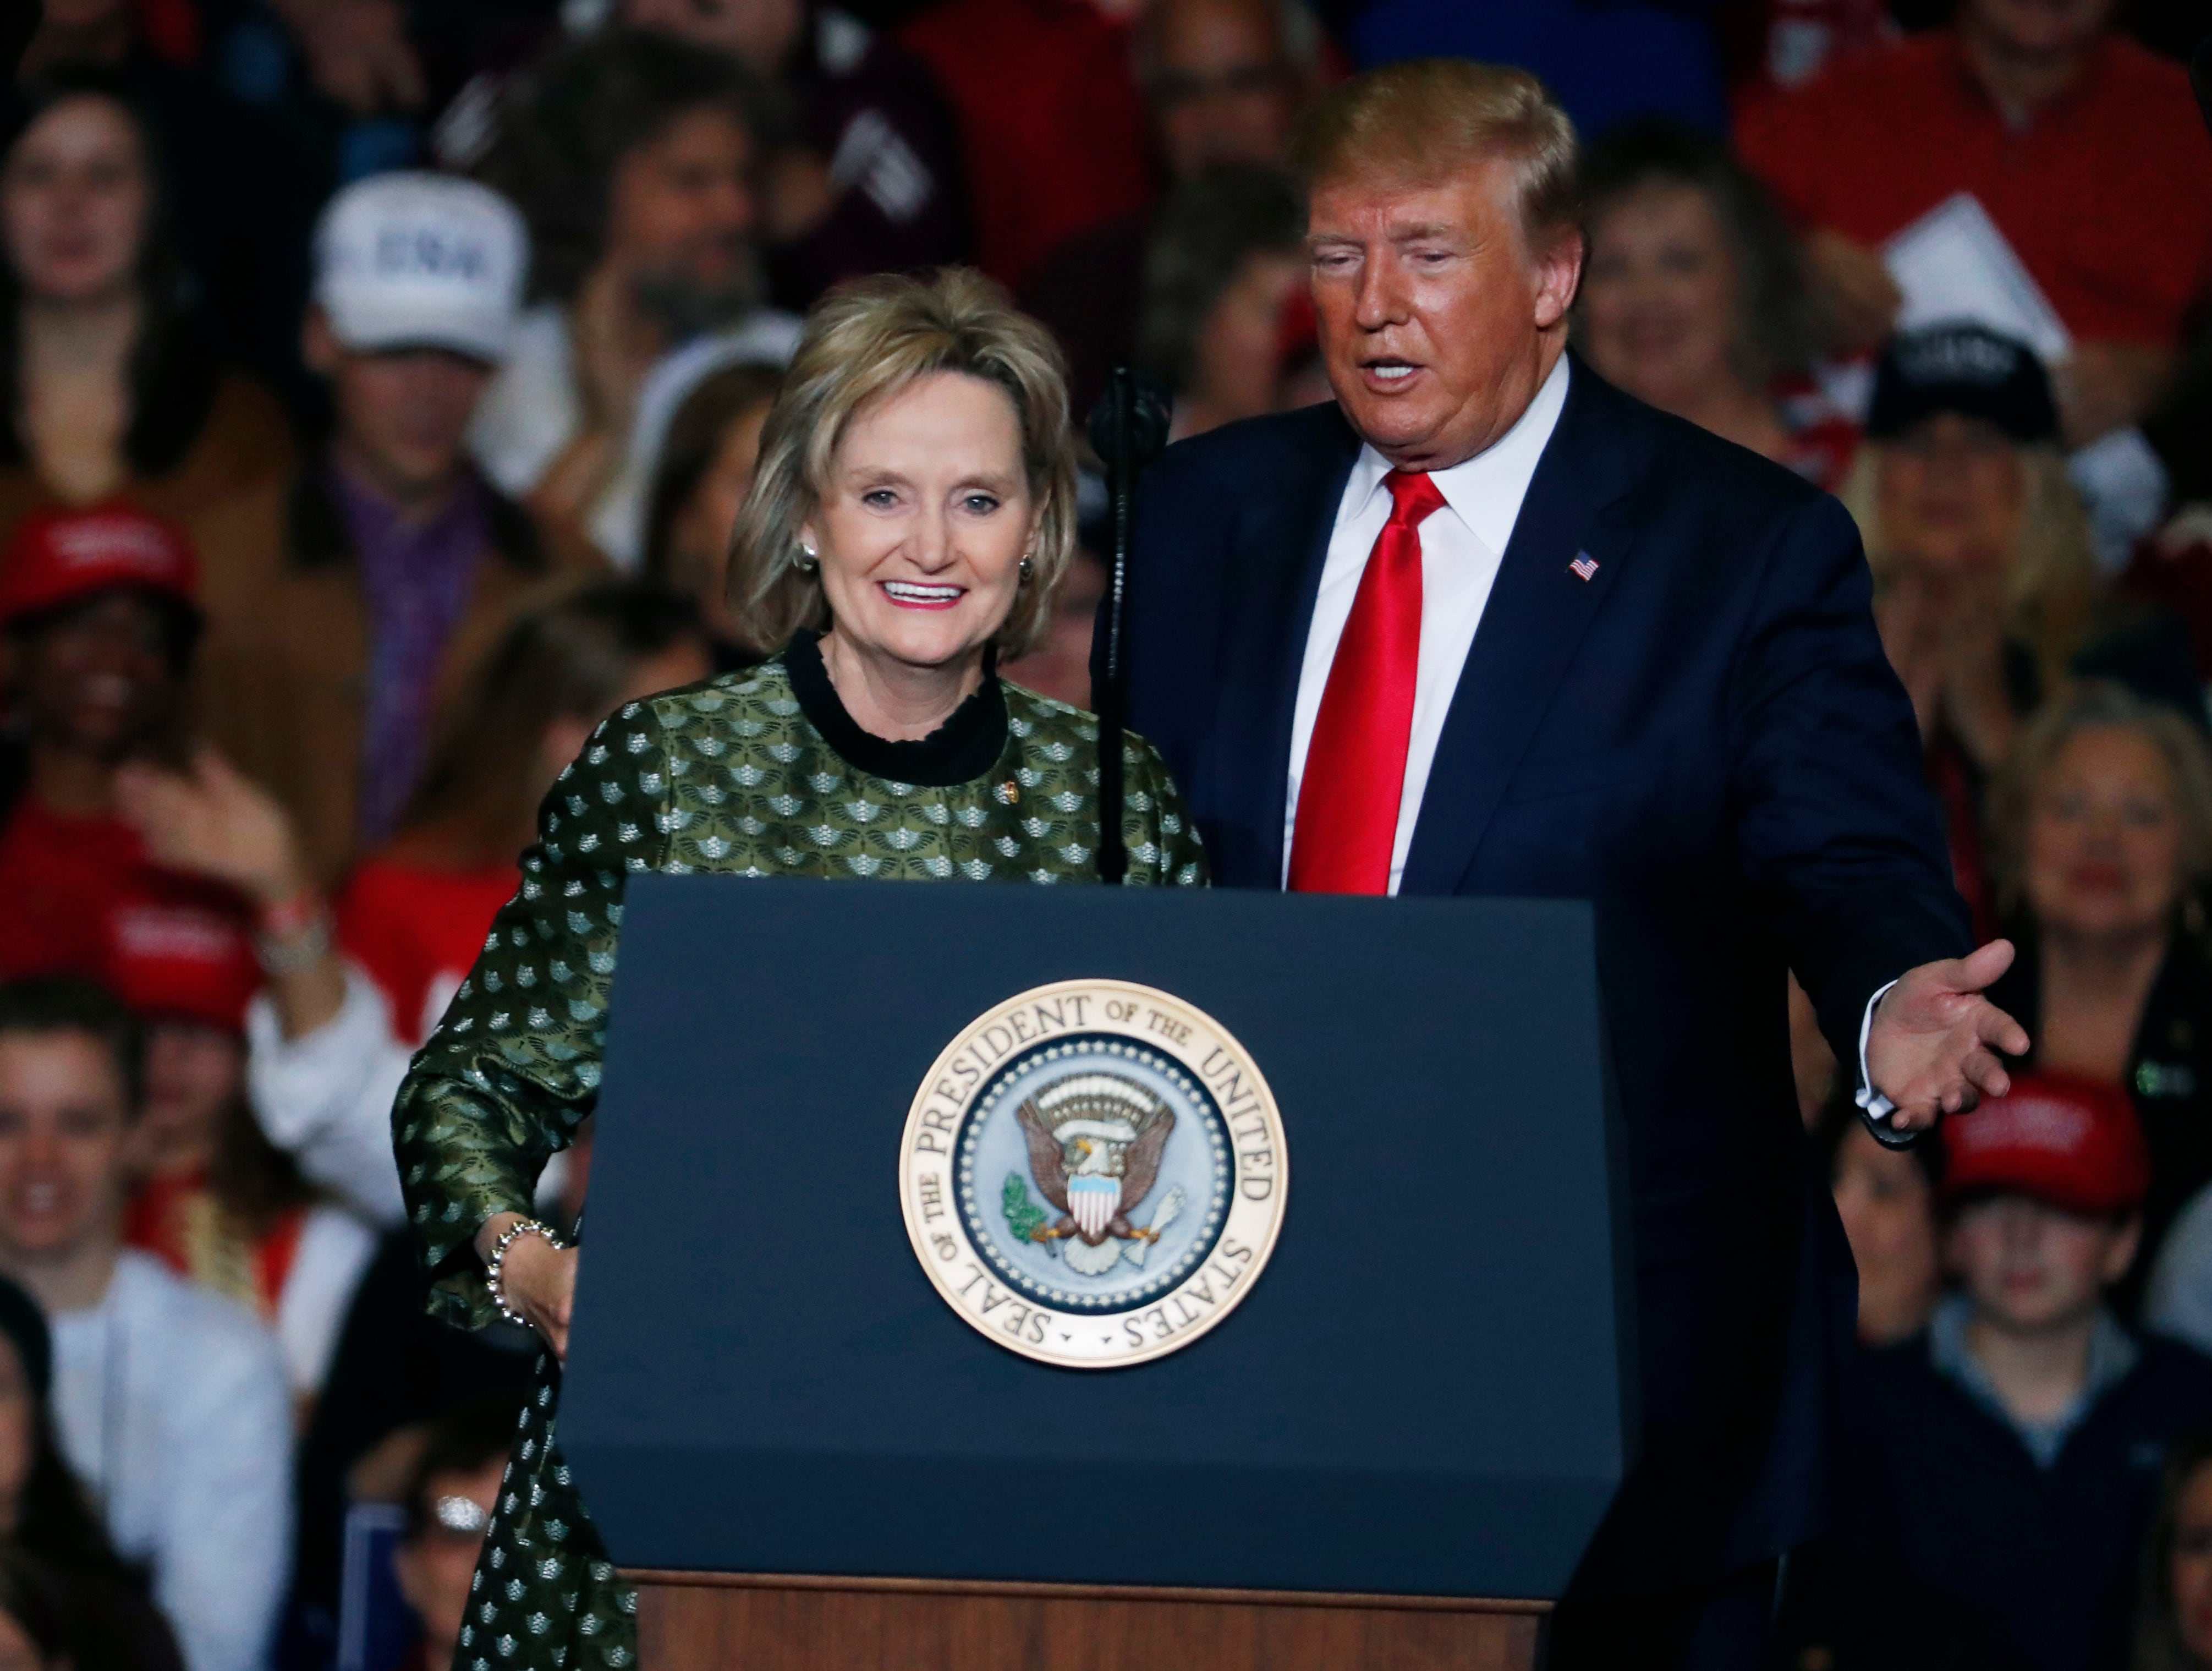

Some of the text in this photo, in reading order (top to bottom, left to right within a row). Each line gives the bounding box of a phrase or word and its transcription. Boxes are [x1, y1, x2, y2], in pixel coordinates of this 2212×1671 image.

[915, 995, 1272, 1347] SEAL OF THE PRESIDENT OF THE UNITED STATES
